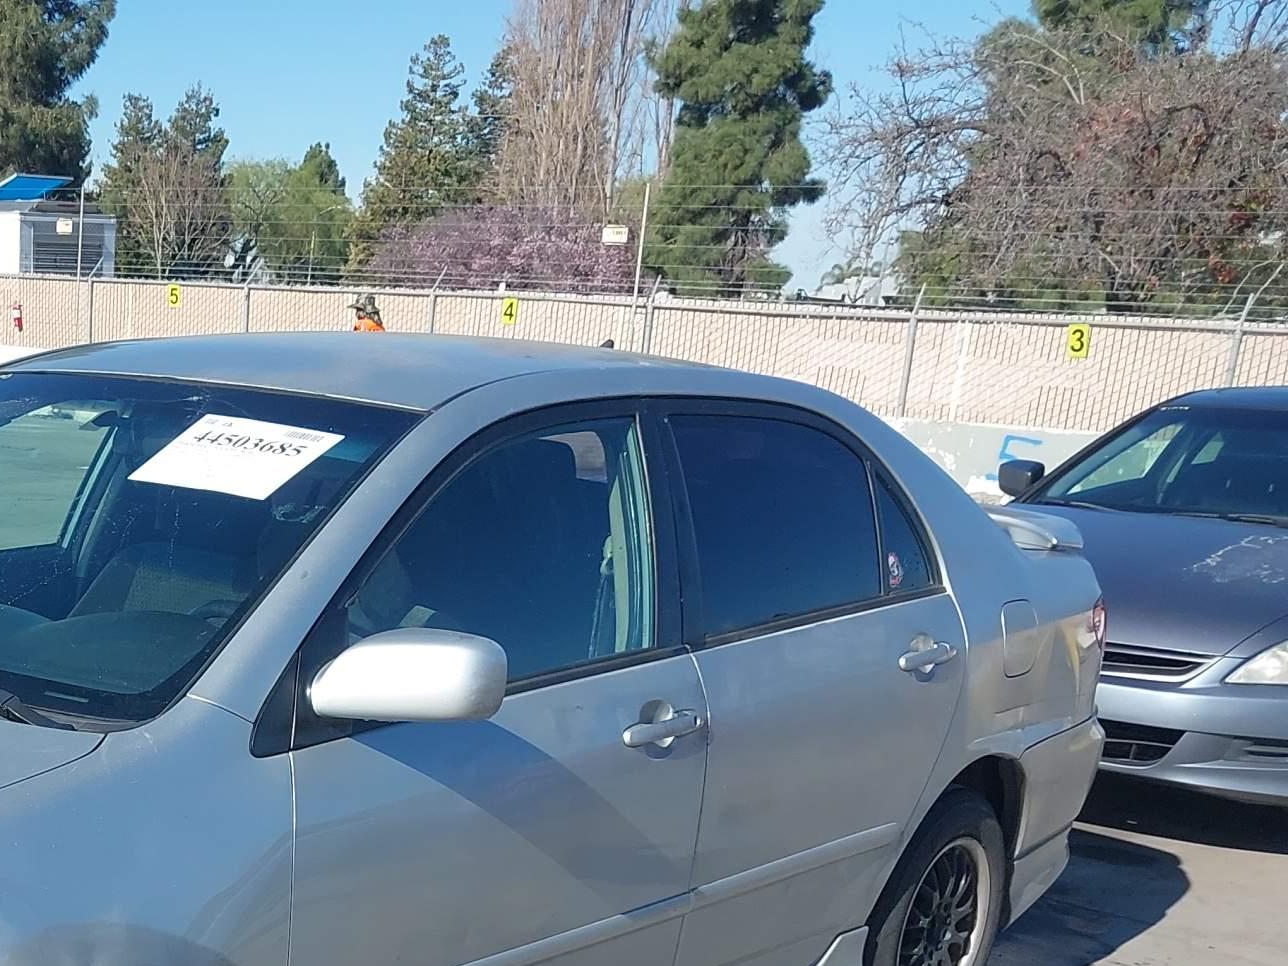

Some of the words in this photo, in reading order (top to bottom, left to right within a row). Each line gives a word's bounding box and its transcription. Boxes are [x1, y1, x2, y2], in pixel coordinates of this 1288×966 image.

[170, 287, 179, 305] 5
[503, 301, 514, 321] 4
[1070, 329, 1085, 353] 3
[193, 430, 308, 457] 44503685
